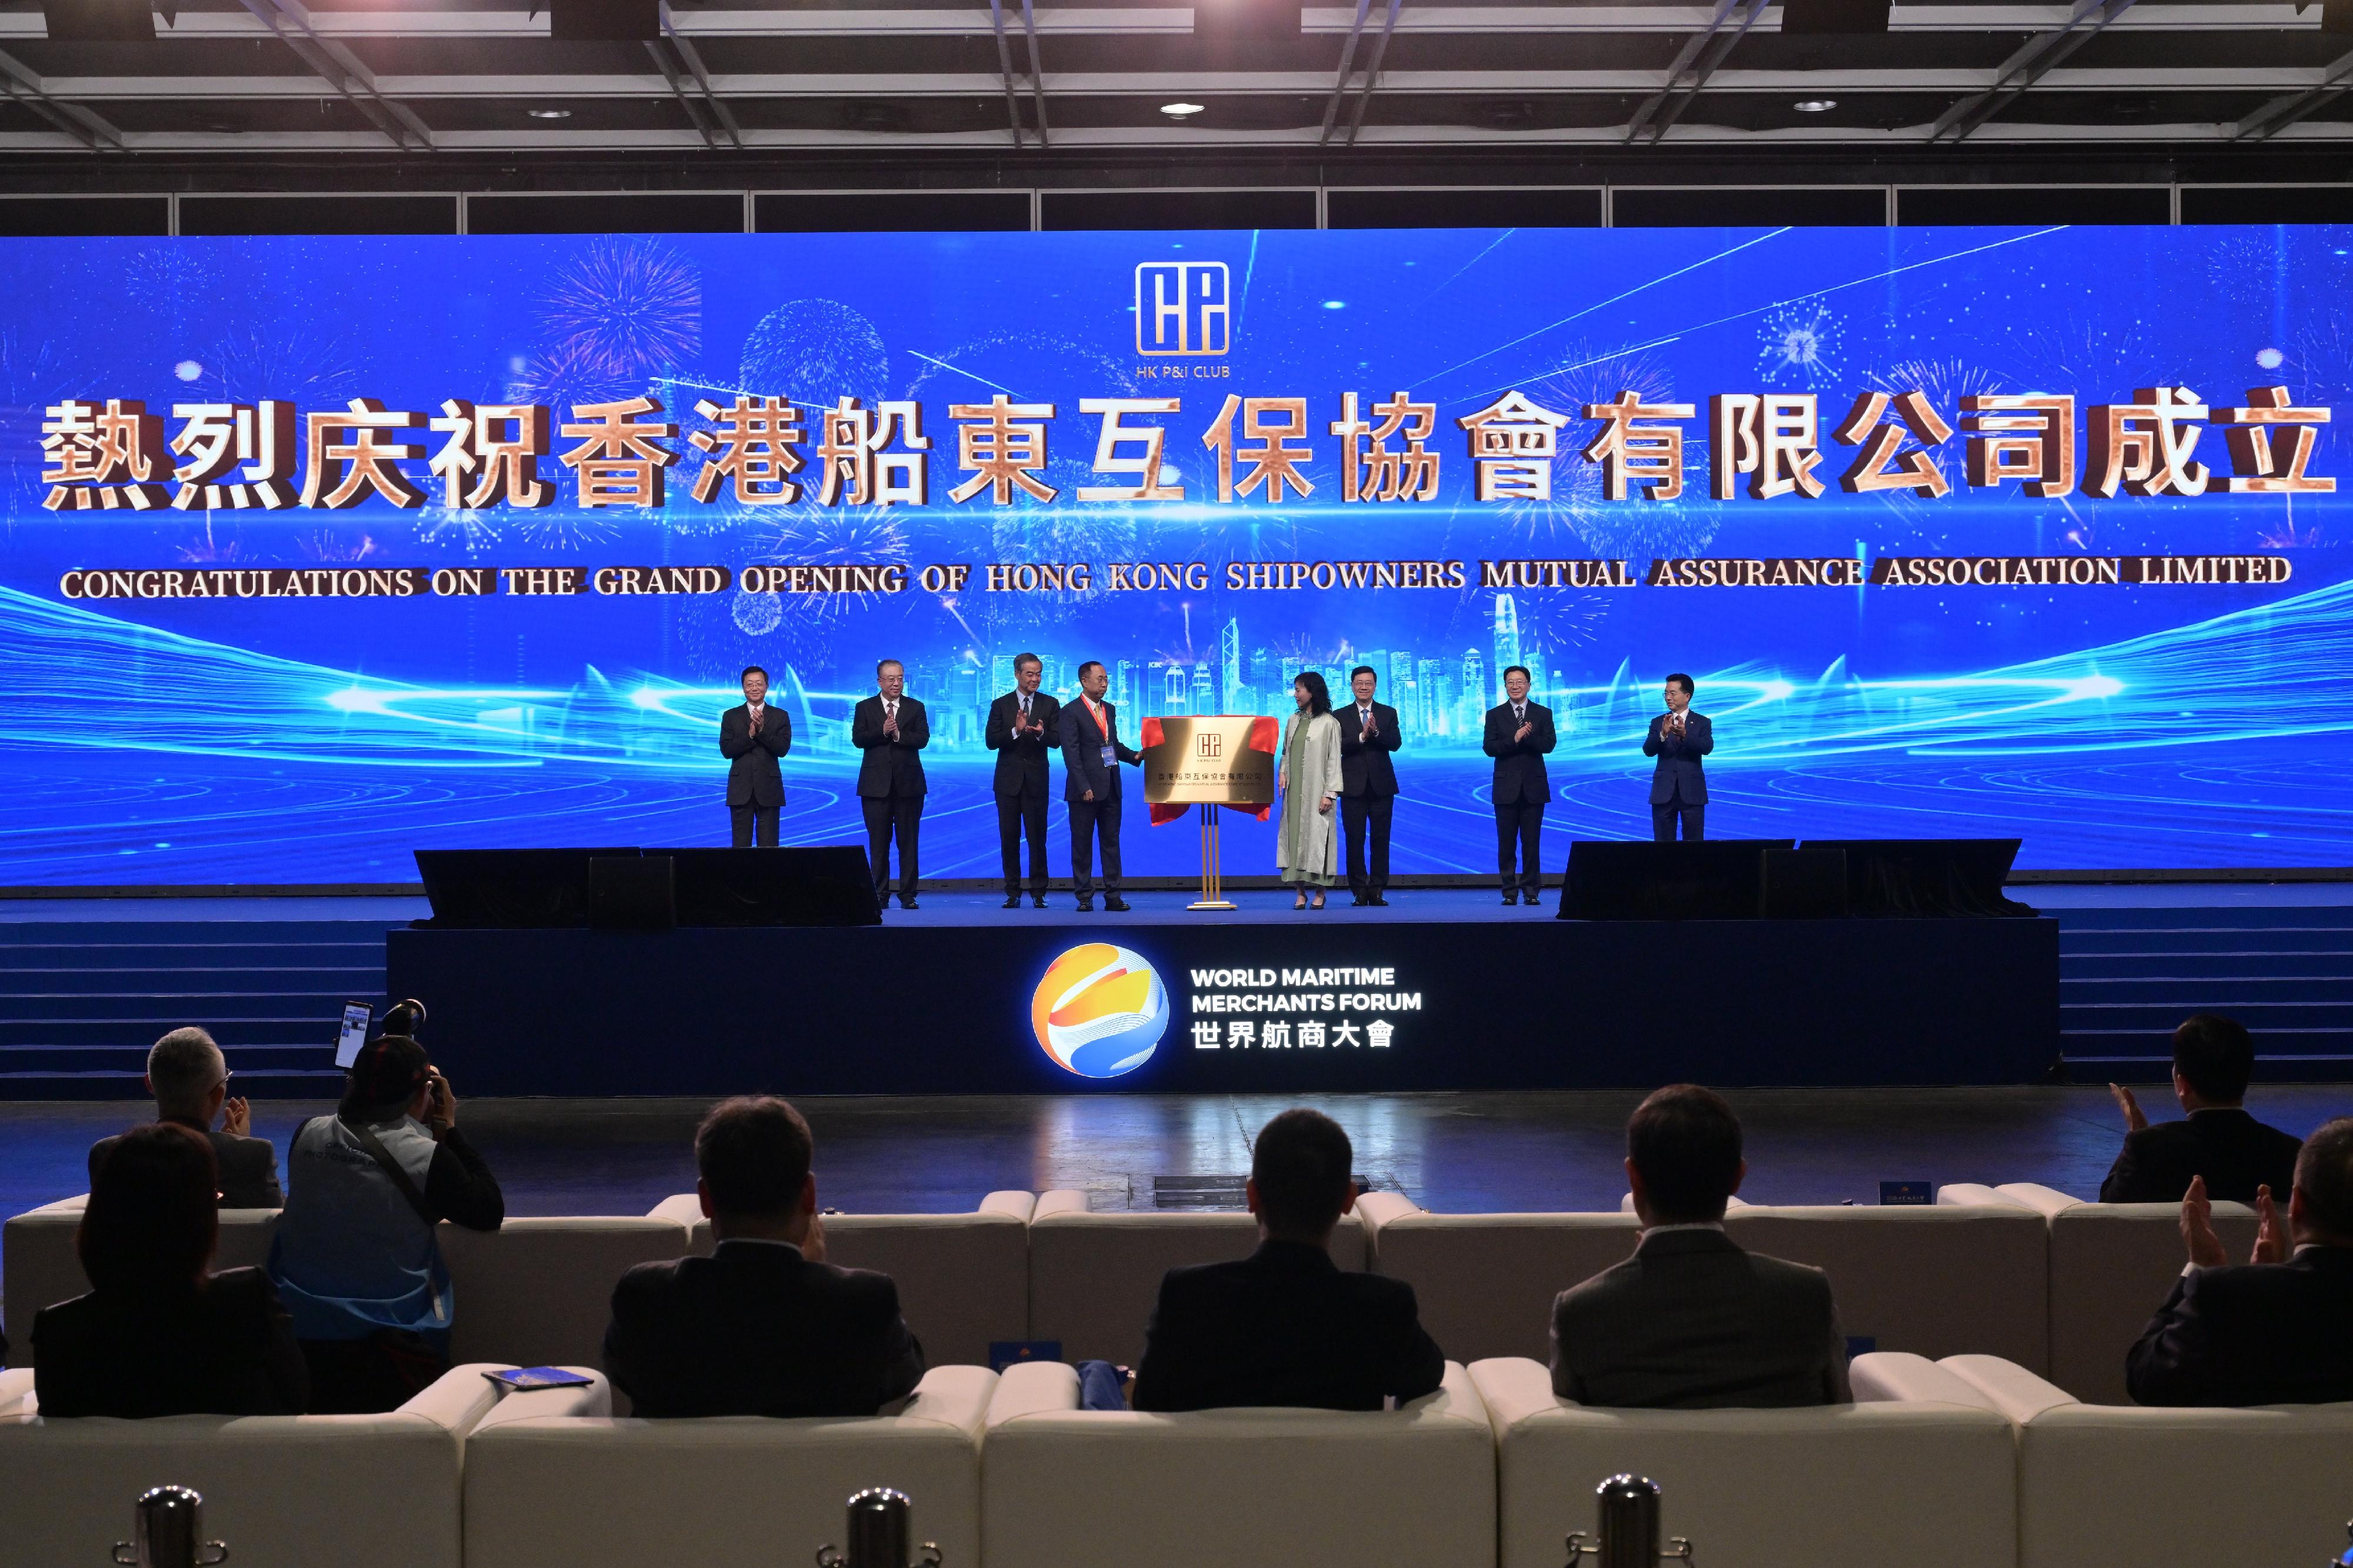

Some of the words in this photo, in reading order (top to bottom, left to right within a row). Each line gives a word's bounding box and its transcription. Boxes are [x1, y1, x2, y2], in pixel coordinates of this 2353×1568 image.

[1136, 366, 1158, 378] HK
[1162, 366, 1188, 378] P&I
[1194, 366, 1230, 378] CLUB
[41, 385, 2337, 511] 熱烈庆祝香港船東互保協會有限公司成立
[59, 570, 414, 599] CONGRATULATIONS
[431, 569, 484, 596] ON
[501, 569, 576, 595] THE
[594, 568, 722, 595] GRAND
[739, 566, 904, 595] OPENING
[920, 565, 968, 592] OF
[986, 565, 1091, 592] HONG
[1109, 563, 1209, 591] KONG
[1227, 562, 1466, 590] SHIPOWNERS
[1484, 561, 1637, 589] MUTUAL
[1654, 559, 1865, 588] ASSURANCE
[1882, 558, 2121, 586] ASSOCIATION
[2139, 557, 2292, 585] LIMITED
[1190, 969, 1277, 987] WORLD
[1281, 968, 1395, 986] MARITIME
[1192, 993, 1335, 1013] MERCHANTS
[1339, 992, 1421, 1011] FORUM
[1191, 1019, 1395, 1049] 世界航商大會
